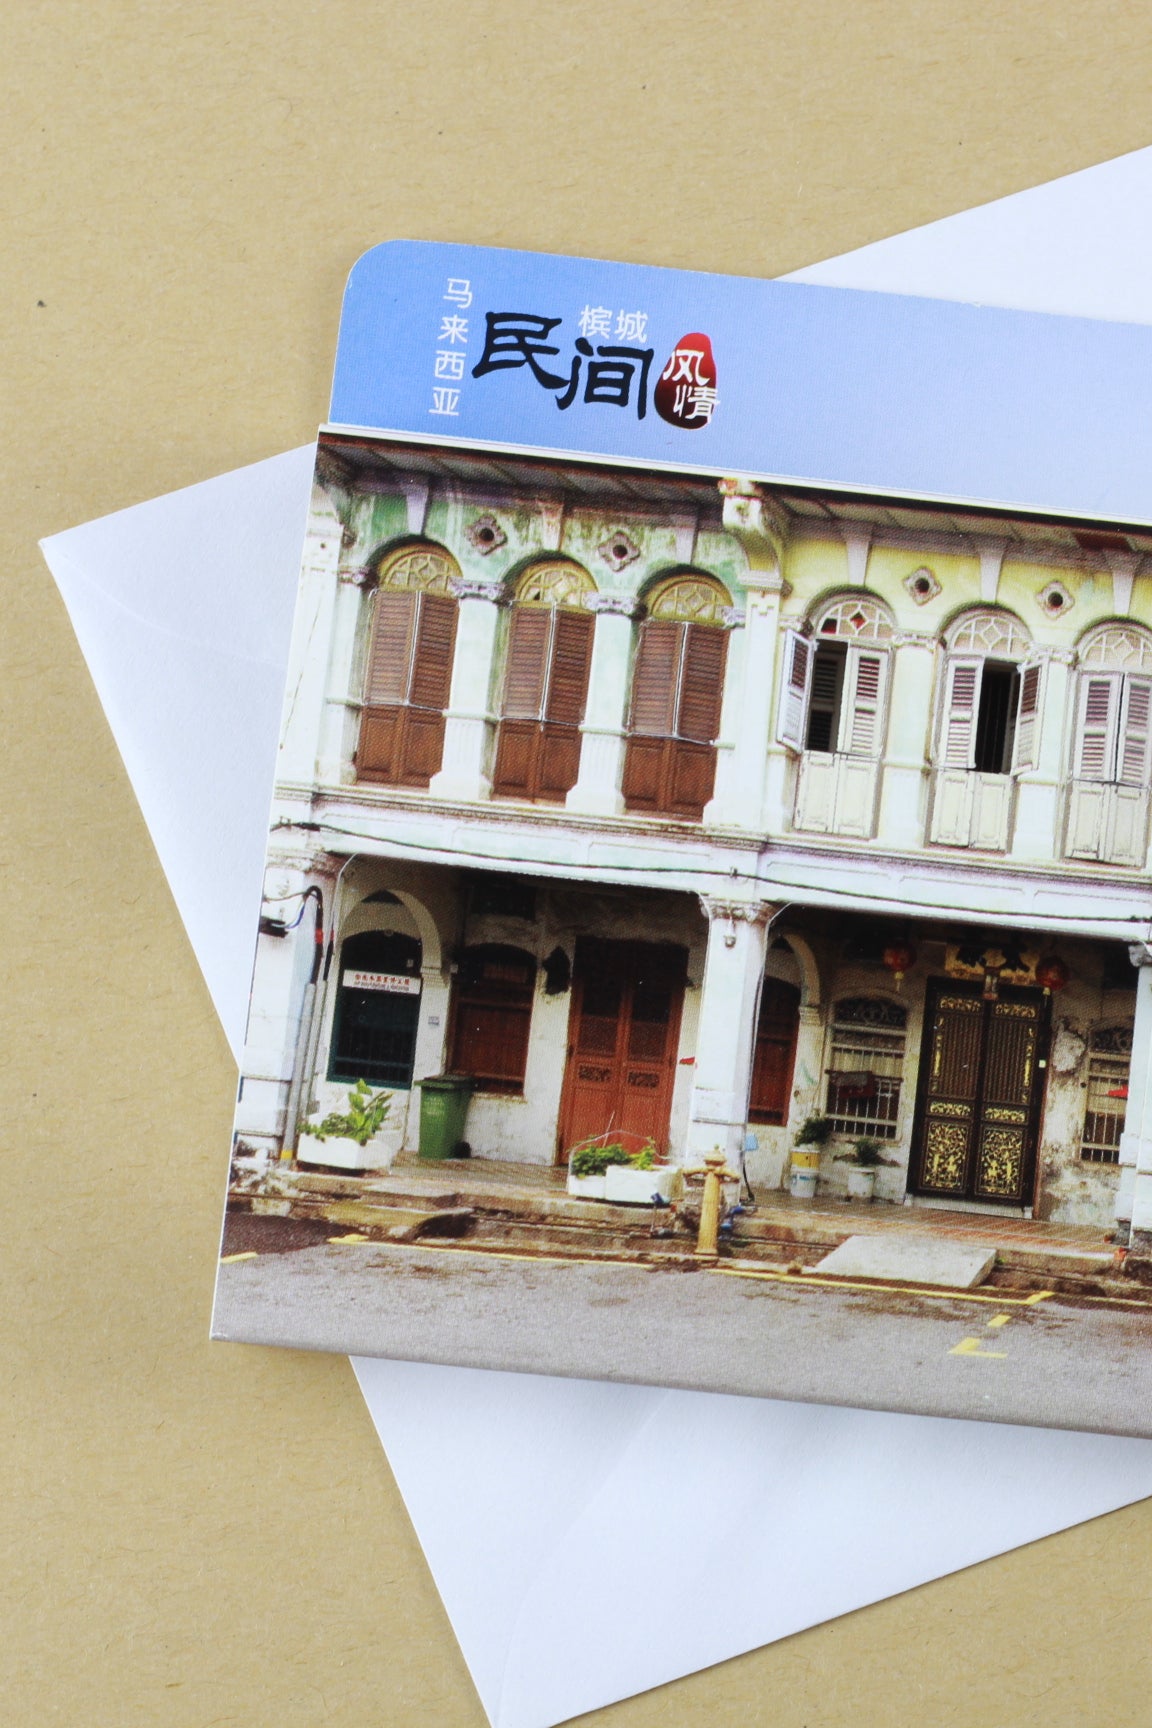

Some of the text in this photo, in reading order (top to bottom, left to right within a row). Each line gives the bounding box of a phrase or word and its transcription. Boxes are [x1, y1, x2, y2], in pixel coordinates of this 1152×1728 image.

[428, 277, 474, 417] 马来西亚
[471, 311, 721, 424] 民间 风情
[577, 304, 649, 344] 槟城
